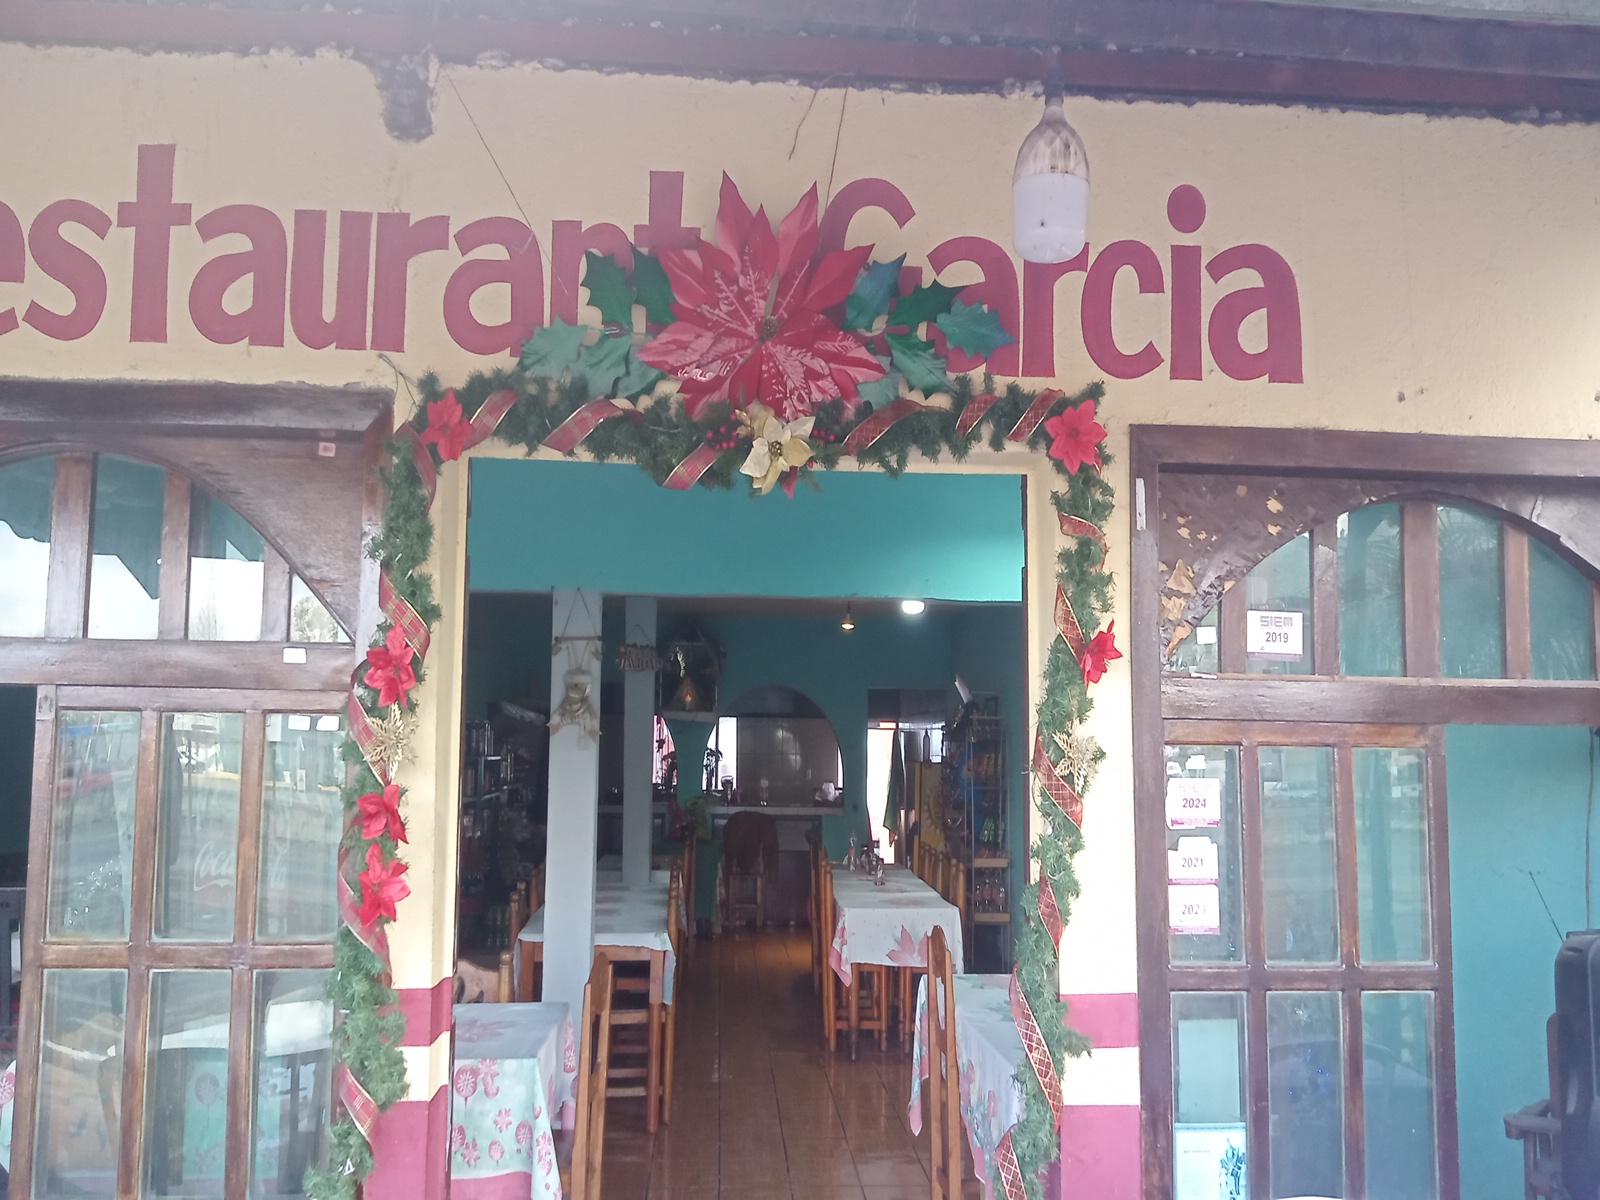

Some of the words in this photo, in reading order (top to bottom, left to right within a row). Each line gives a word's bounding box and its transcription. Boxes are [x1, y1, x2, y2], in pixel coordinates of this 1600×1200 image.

[0, 144, 702, 357] staurant
[1265, 631, 1290, 643] 2019
[1182, 797, 1208, 809] 2024
[1181, 857, 1205, 868] 2021
